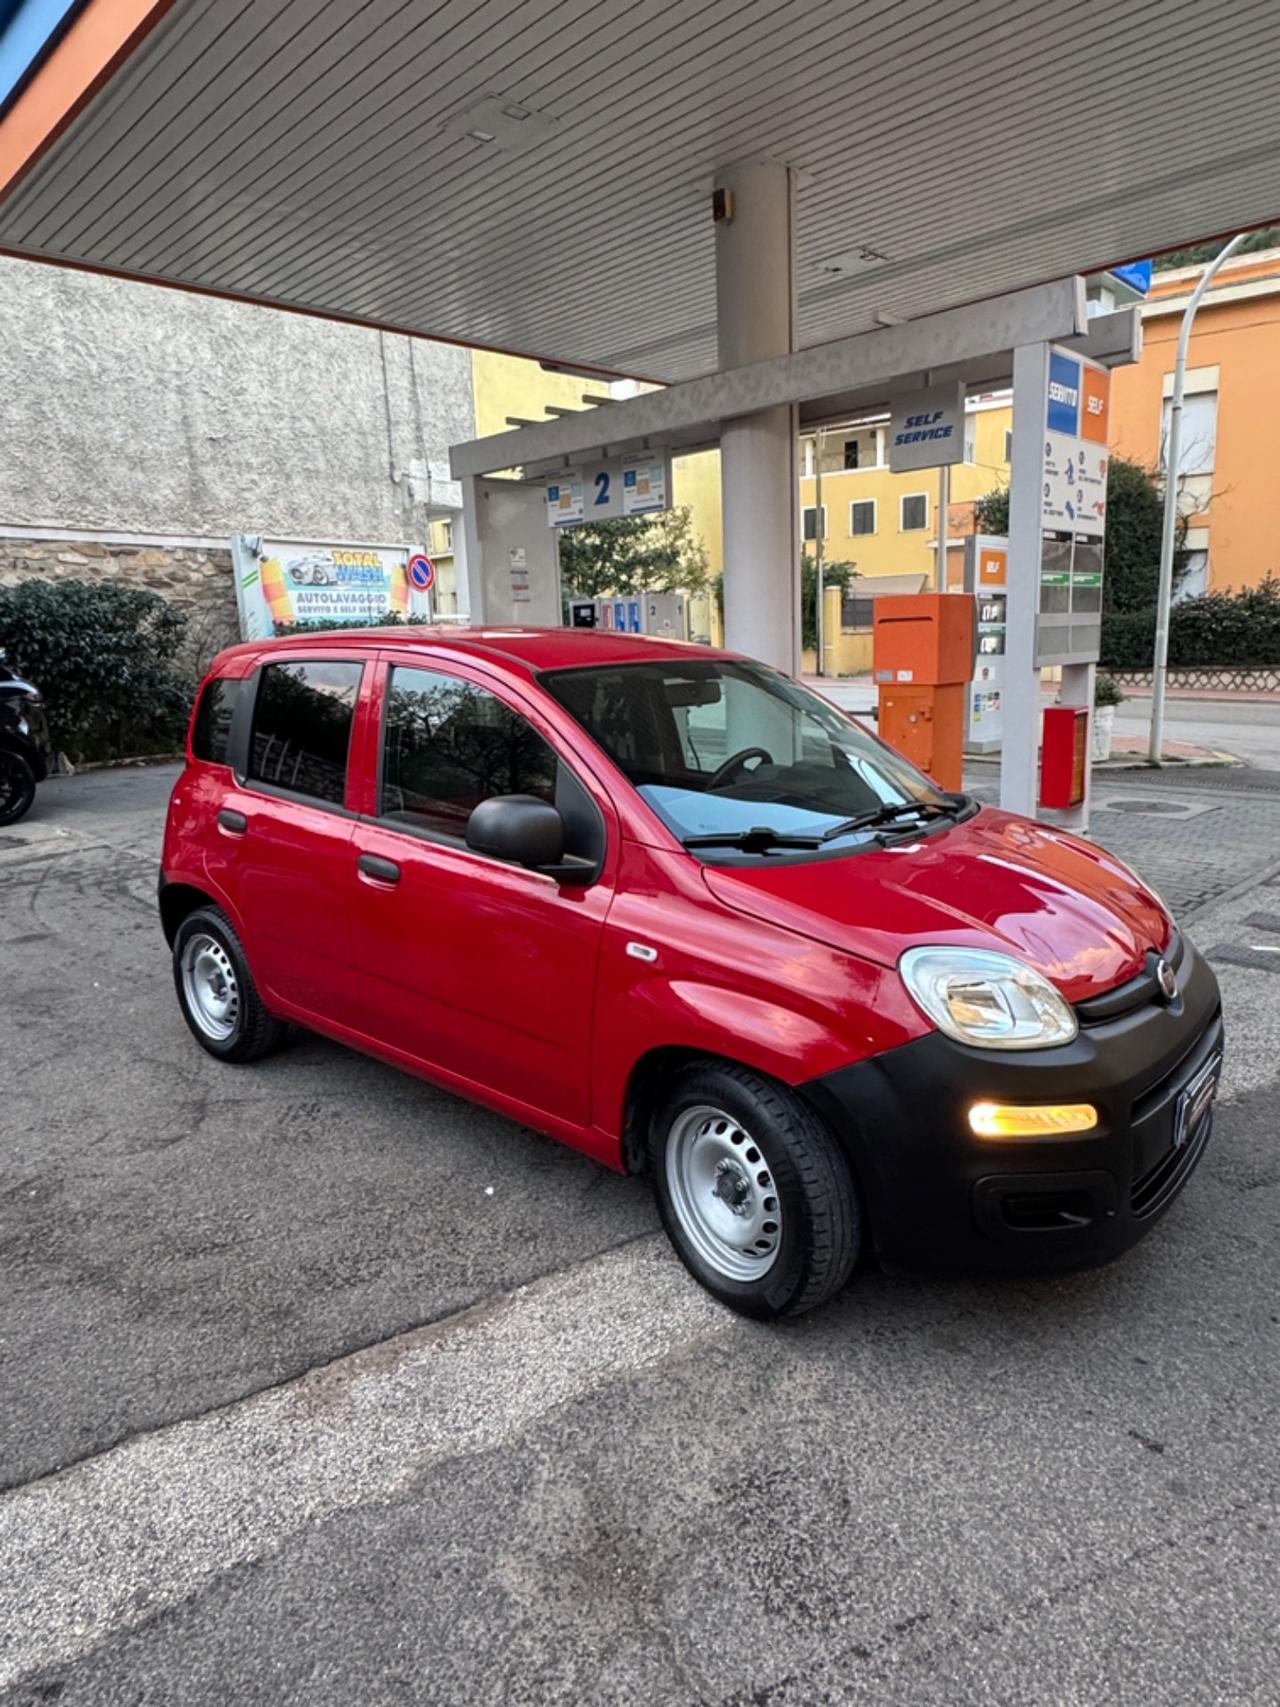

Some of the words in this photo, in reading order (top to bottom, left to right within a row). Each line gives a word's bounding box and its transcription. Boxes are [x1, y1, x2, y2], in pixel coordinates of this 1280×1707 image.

[1087, 395, 1104, 416] SELF
[904, 411, 944, 429] SELF
[894, 425, 954, 446] SERVICE
[593, 471, 611, 506] 2
[332, 551, 383, 567] TOTAL
[297, 593, 386, 604] AUTOLAVAGGIO
[298, 605, 331, 614] SERVITO
[340, 606, 357, 614] SELF
[650, 604, 656, 616] 2
